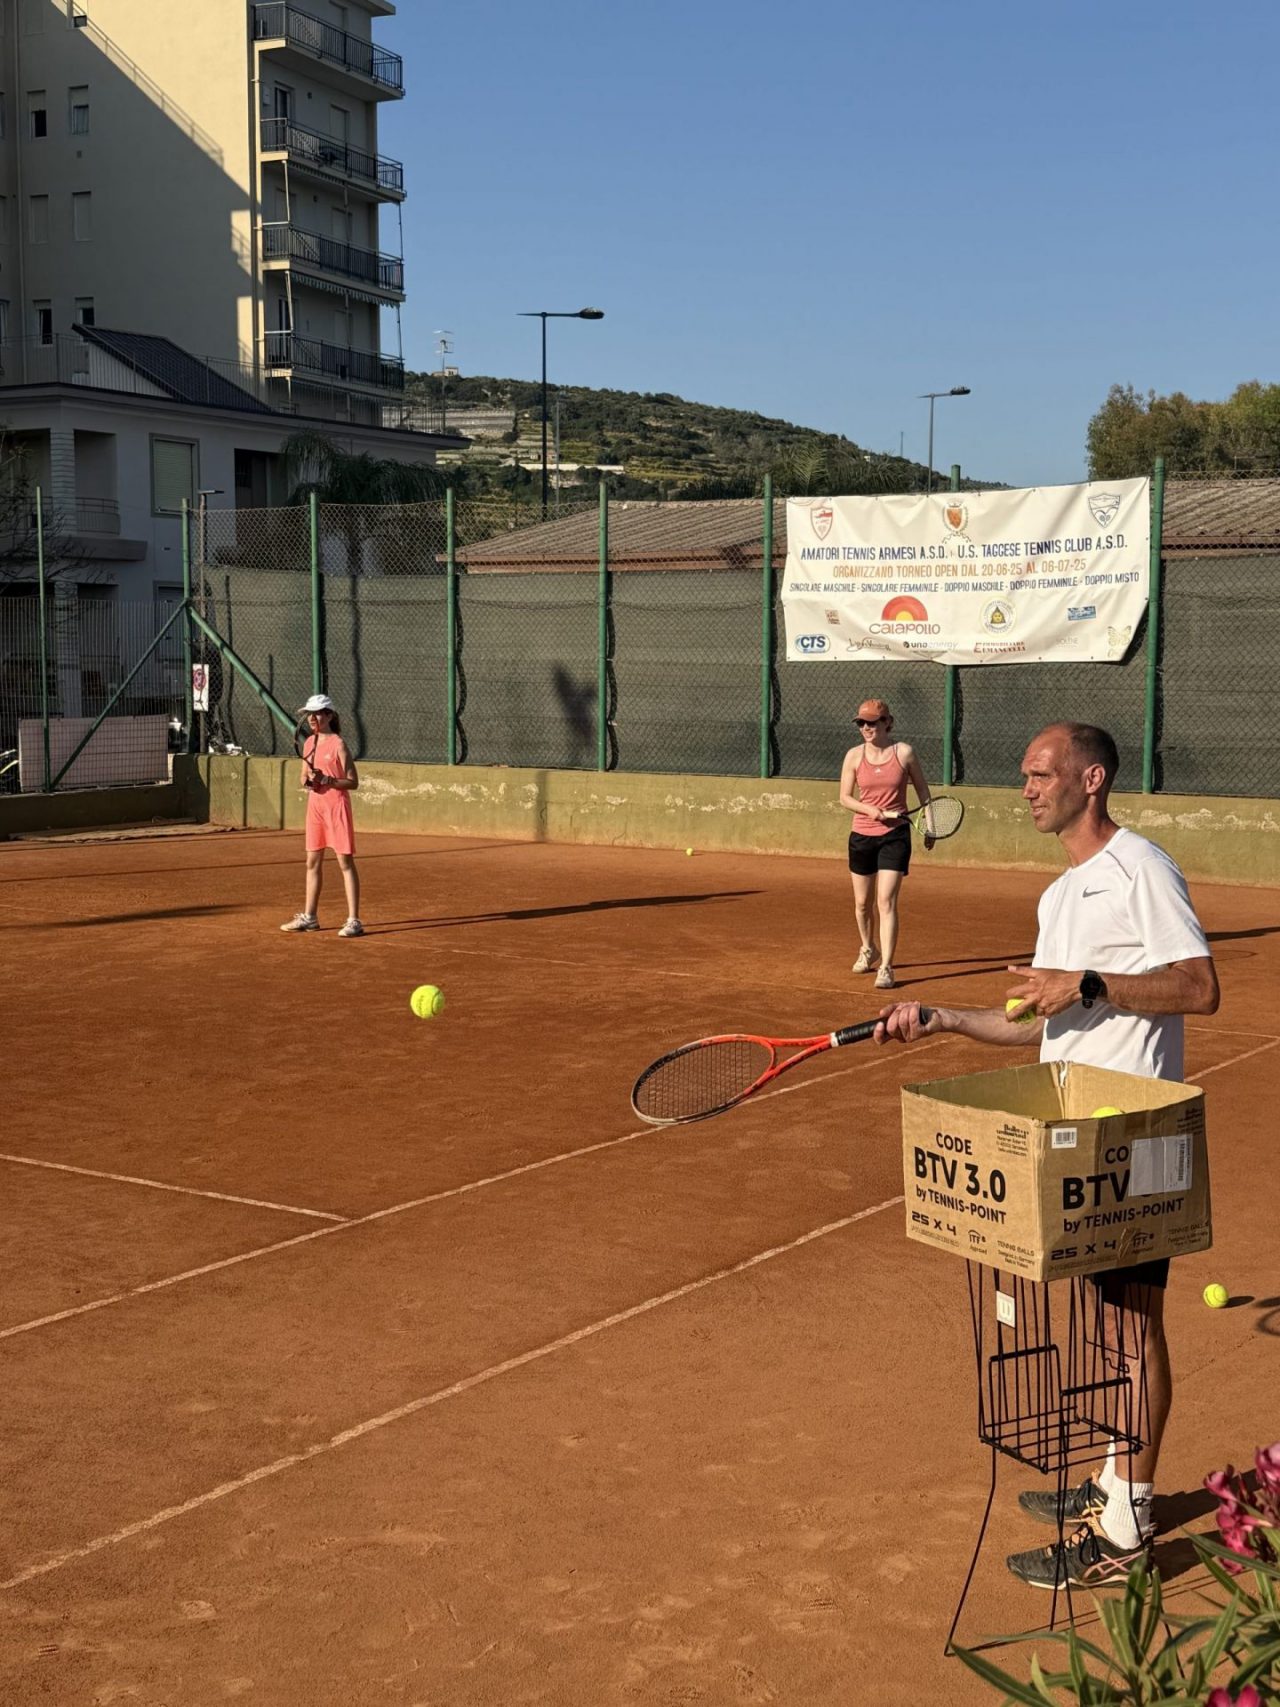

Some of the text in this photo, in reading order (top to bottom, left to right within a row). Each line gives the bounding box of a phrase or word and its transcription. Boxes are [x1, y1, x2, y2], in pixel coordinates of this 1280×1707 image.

[801, 547, 840, 560] AMATORI
[843, 547, 875, 560] TENNIS
[879, 546, 916, 560] ARMESI
[920, 546, 948, 560] A.S.D.
[958, 544, 978, 559] U.S.
[1024, 539, 1062, 555] TENNIS
[1065, 537, 1092, 552] CLUB
[1095, 534, 1128, 550] A.S.D.
[833, 558, 1086, 578] ORGANIZZANO TORNEO OPEN DAL 20-06-25 AL 06-07-25
[823, 583, 857, 593] MASCHILE
[861, 583, 898, 593] SINGOLARE
[899, 582, 939, 593] FEMMINILE
[944, 582, 970, 593] DOPPIO
[971, 581, 1004, 592] MASCHILE
[1010, 579, 1036, 590] DOPPIO
[1038, 576, 1078, 589] FEMMINILE
[1085, 574, 1113, 586] DOPPIO
[1115, 571, 1140, 584] MISTO
[800, 635, 826, 649] CTS
[935, 1132, 973, 1156] CODE
[1105, 1146, 1129, 1164] CO
[914, 1146, 1006, 1203] BTV 3.0
[1063, 1169, 1131, 1211] BTV
[915, 1183, 1007, 1225] by TENNIS-POINT
[1063, 1198, 1185, 1234] by TENNIS-POINT
[911, 1210, 929, 1226] 25
[946, 1223, 957, 1236] 4
[1051, 1247, 1078, 1260] 25
[1104, 1240, 1117, 1250] 4
